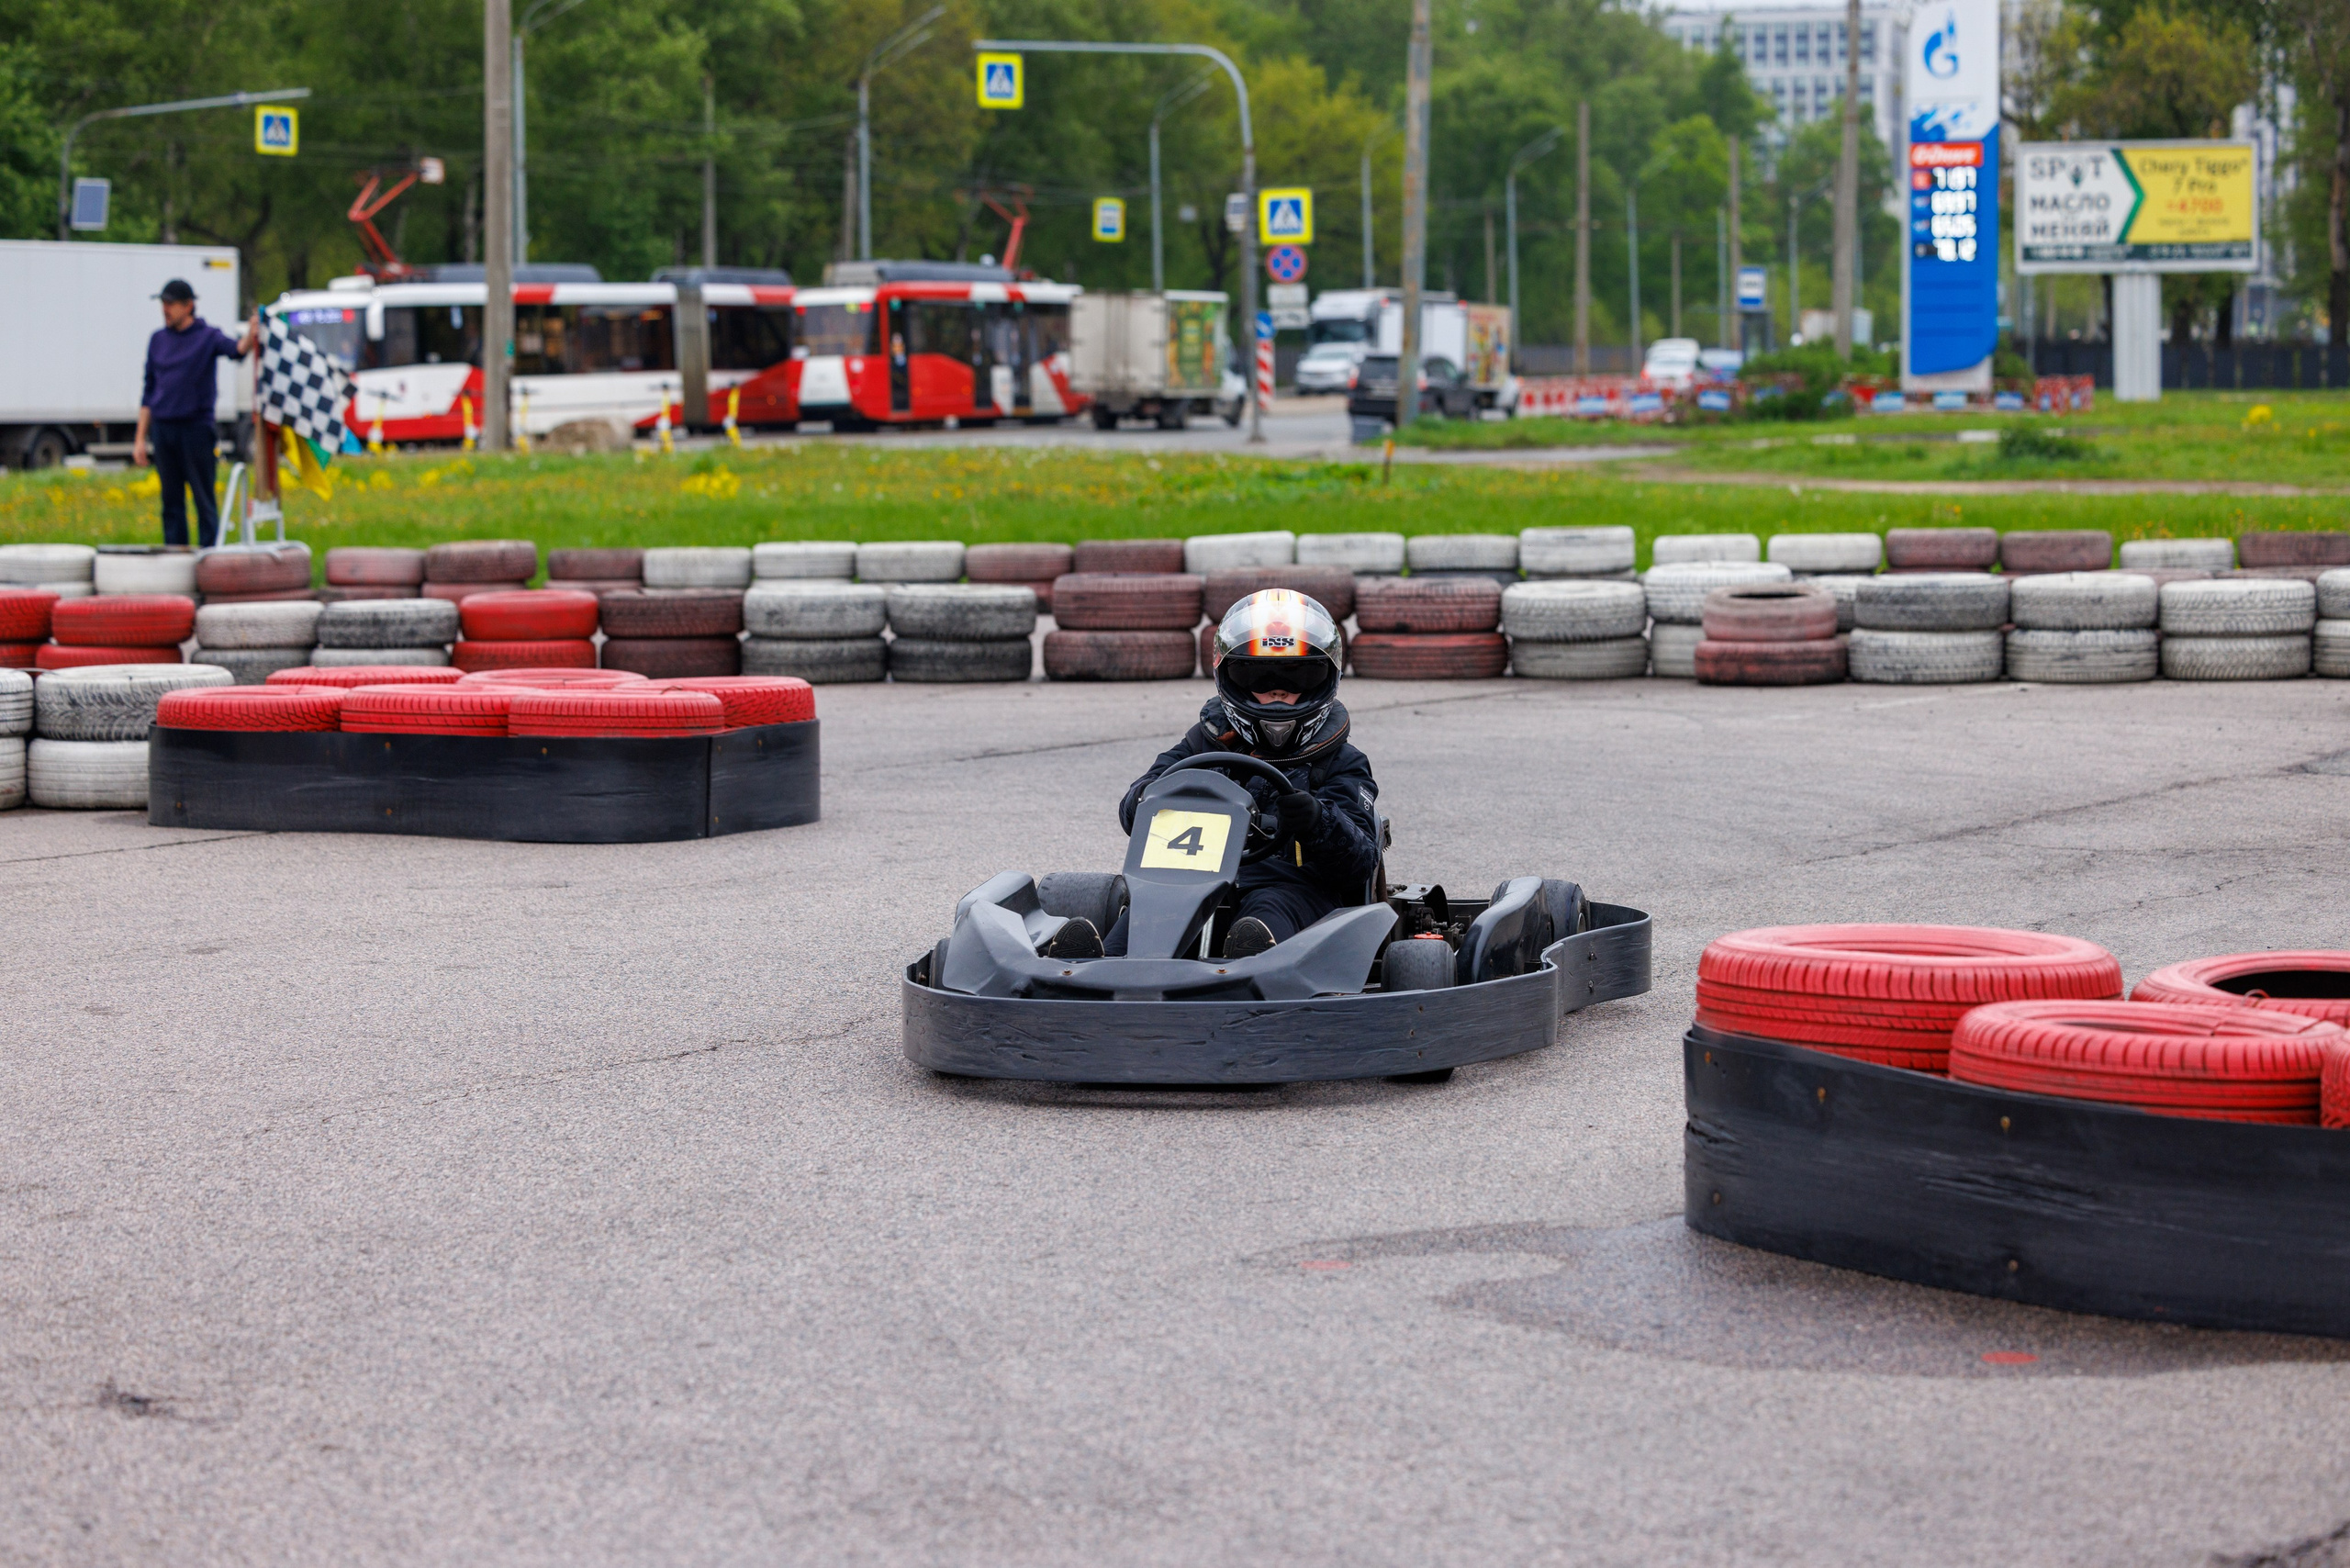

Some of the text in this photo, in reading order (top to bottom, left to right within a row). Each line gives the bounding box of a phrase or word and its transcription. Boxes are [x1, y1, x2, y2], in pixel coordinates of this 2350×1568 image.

[2031, 194, 2110, 212] МАСЛО
[2031, 217, 2109, 237] МЕНЯЙ
[1167, 826, 1203, 856] 4
